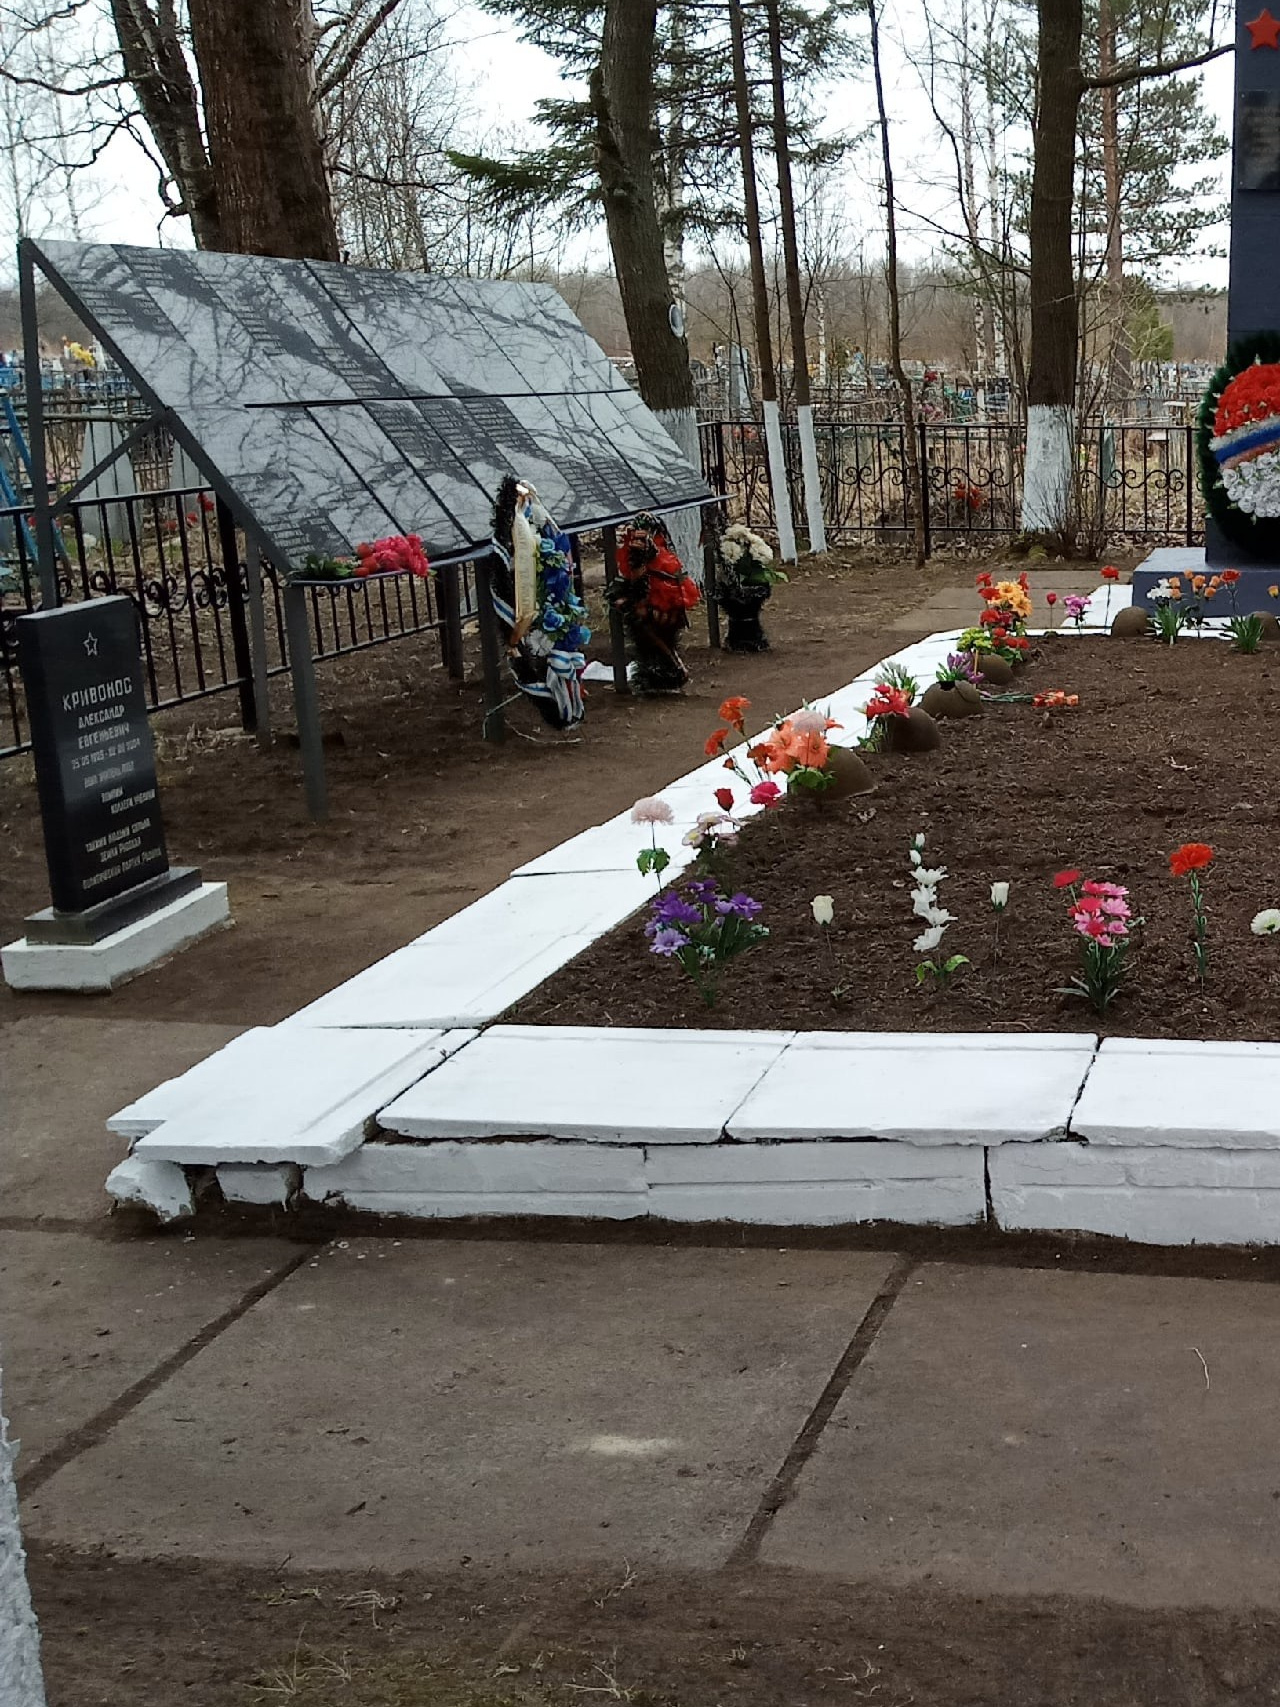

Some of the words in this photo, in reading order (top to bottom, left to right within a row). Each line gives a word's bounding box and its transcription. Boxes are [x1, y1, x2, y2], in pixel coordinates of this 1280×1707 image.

[62, 676, 133, 711] КРИВОНОС
[78, 704, 125, 729] АЛЕКСАНДР
[78, 721, 130, 750] ЕВГЕНЬЕВИЧ
